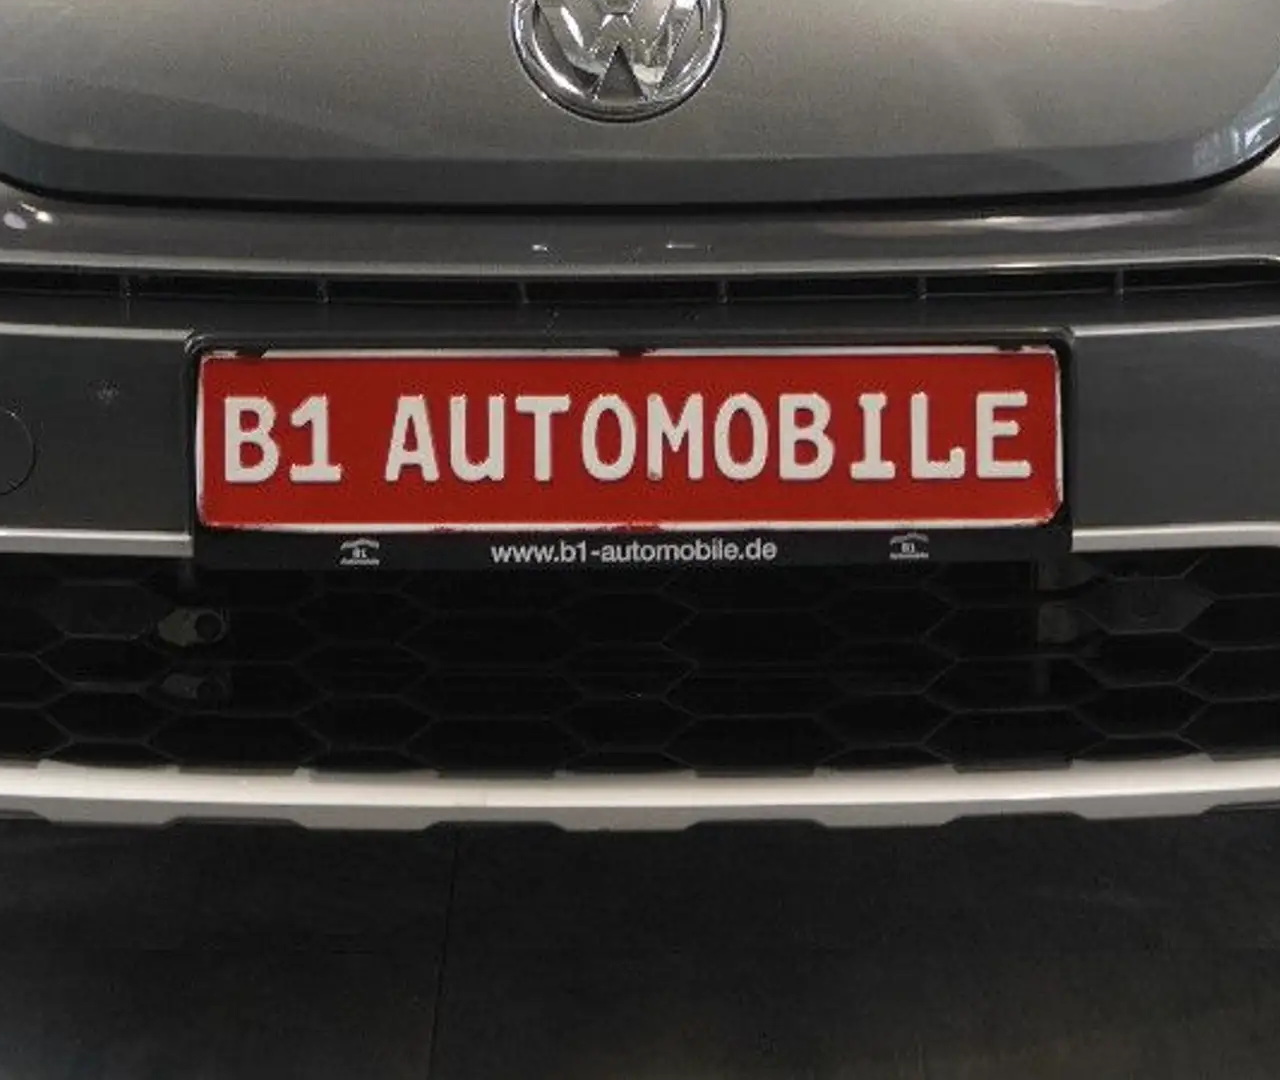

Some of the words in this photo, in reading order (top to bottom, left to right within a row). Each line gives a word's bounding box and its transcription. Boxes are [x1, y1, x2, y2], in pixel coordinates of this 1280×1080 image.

[223, 395, 342, 482] B1
[385, 391, 1032, 482] AUTOMOBILE
[490, 538, 778, 563] www.b1-automobile.de
